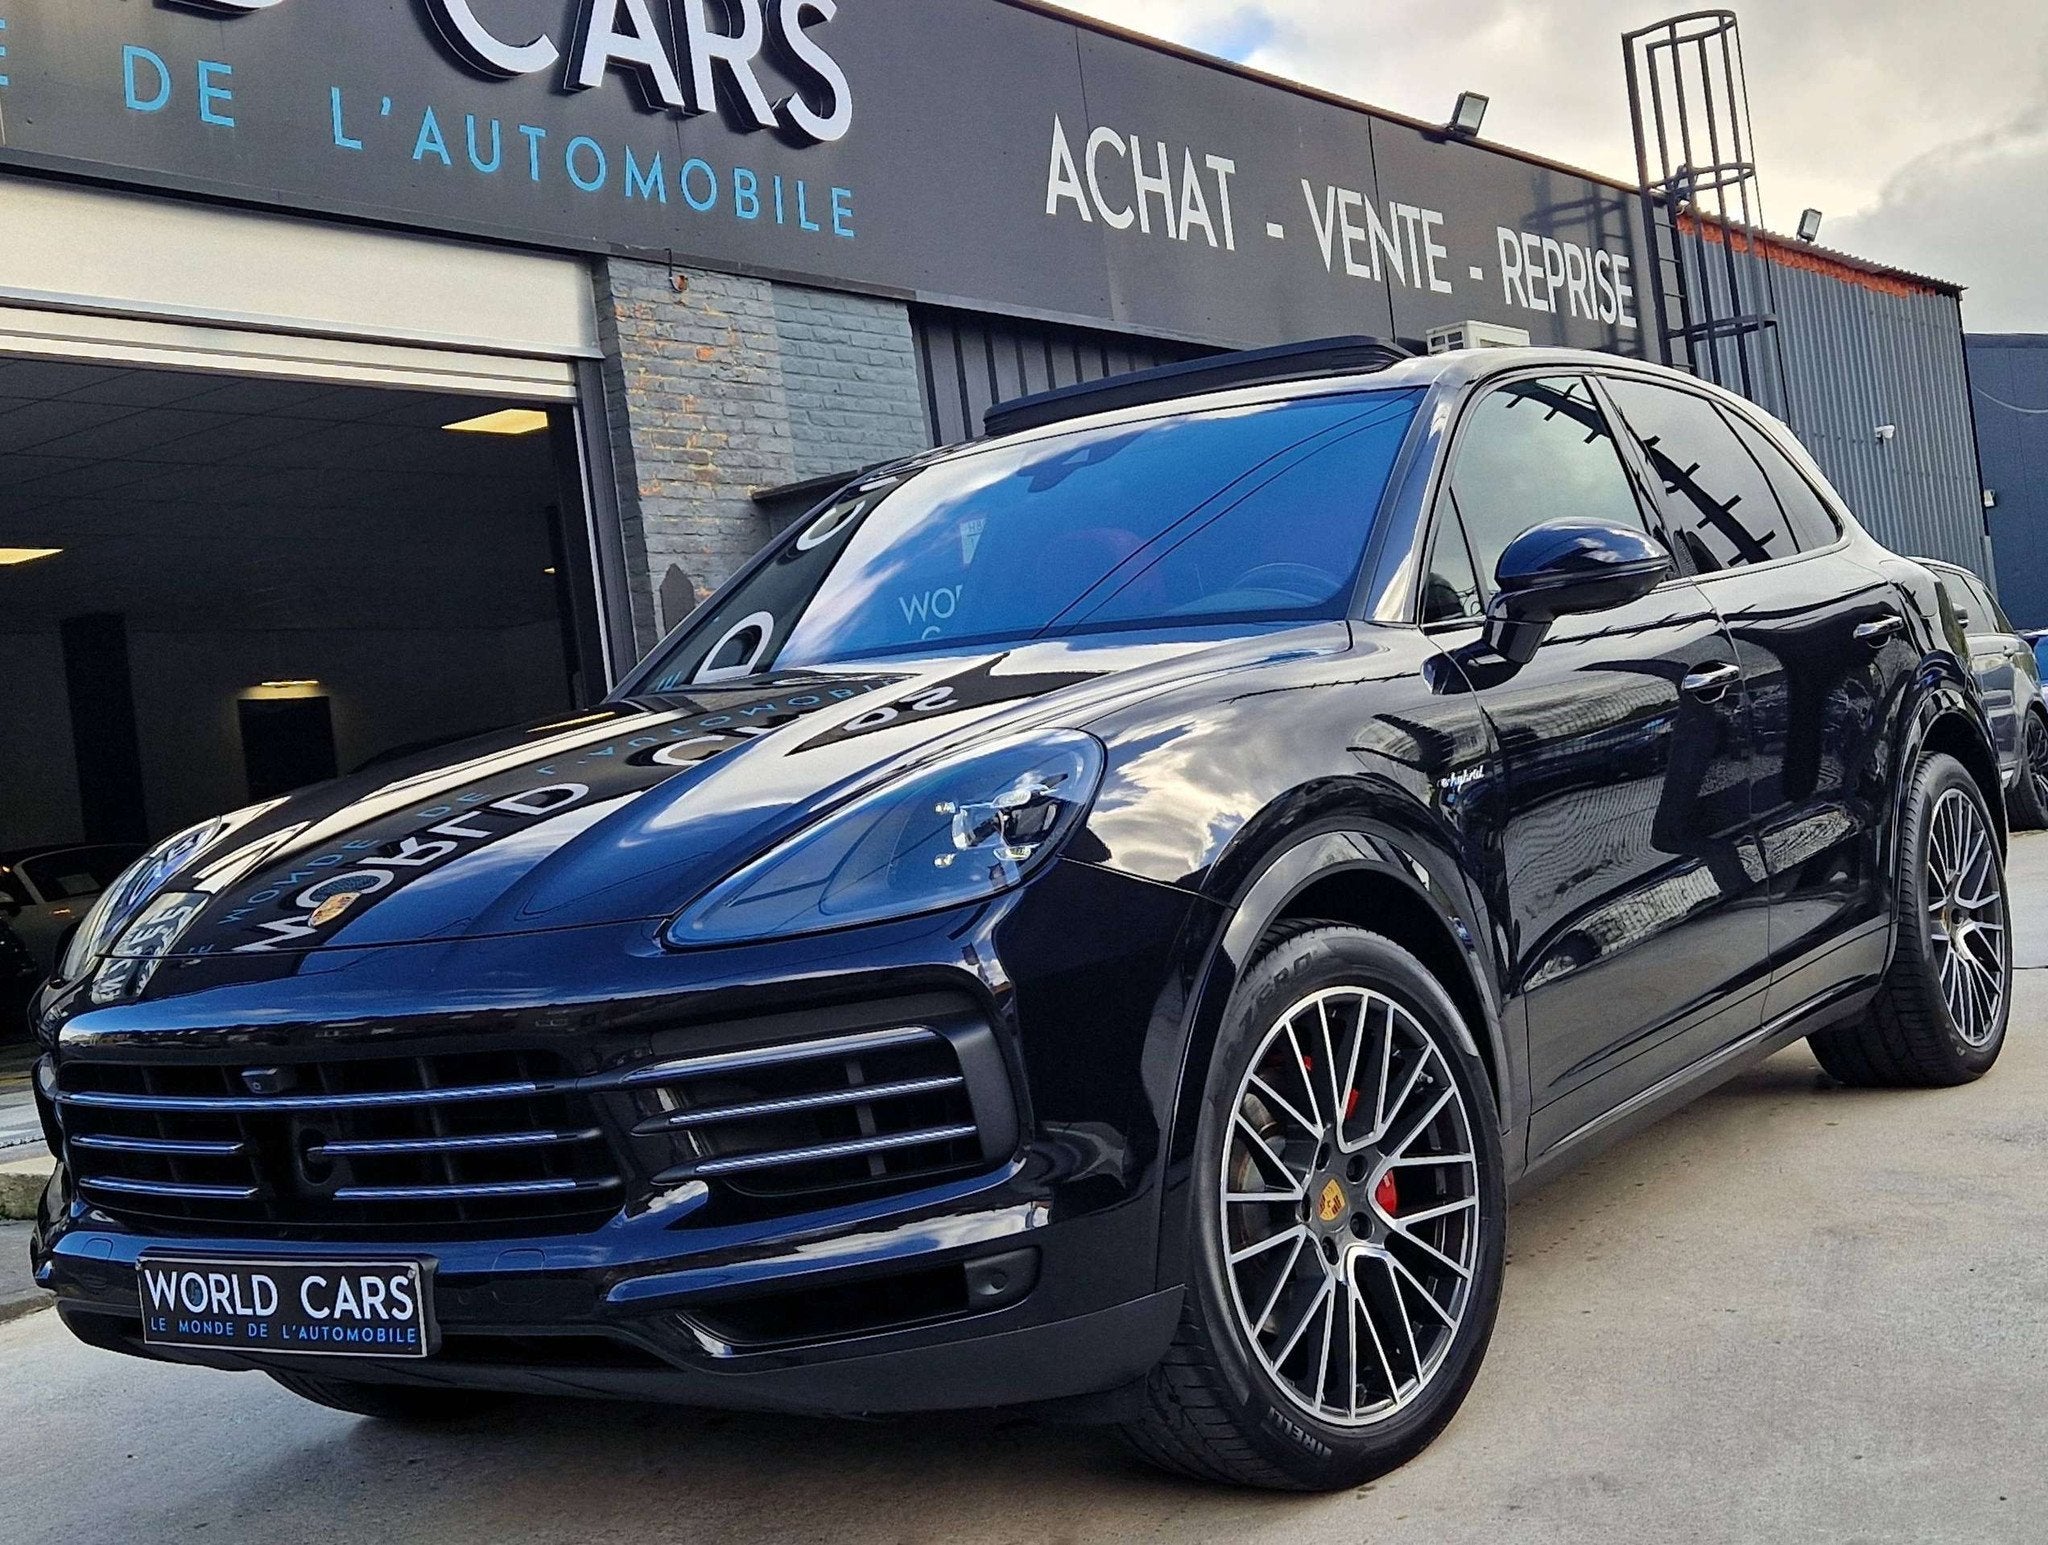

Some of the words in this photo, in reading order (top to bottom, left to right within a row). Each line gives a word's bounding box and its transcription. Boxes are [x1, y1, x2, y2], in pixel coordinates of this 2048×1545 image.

[122, 44, 235, 128] DE
[330, 86, 855, 238] L'AUTOMOBILE
[1045, 113, 1235, 251] ACHAT
[1301, 178, 1453, 294] VENTE
[1497, 226, 1637, 328] REPRISE
[144, 1269, 278, 1316] WORLD
[301, 1275, 414, 1320] CARS
[151, 1317, 167, 1331] LE
[178, 1319, 235, 1336] MONDE
[248, 1322, 268, 1338] DE
[282, 1325, 416, 1343] L'AUTOMOBILE
